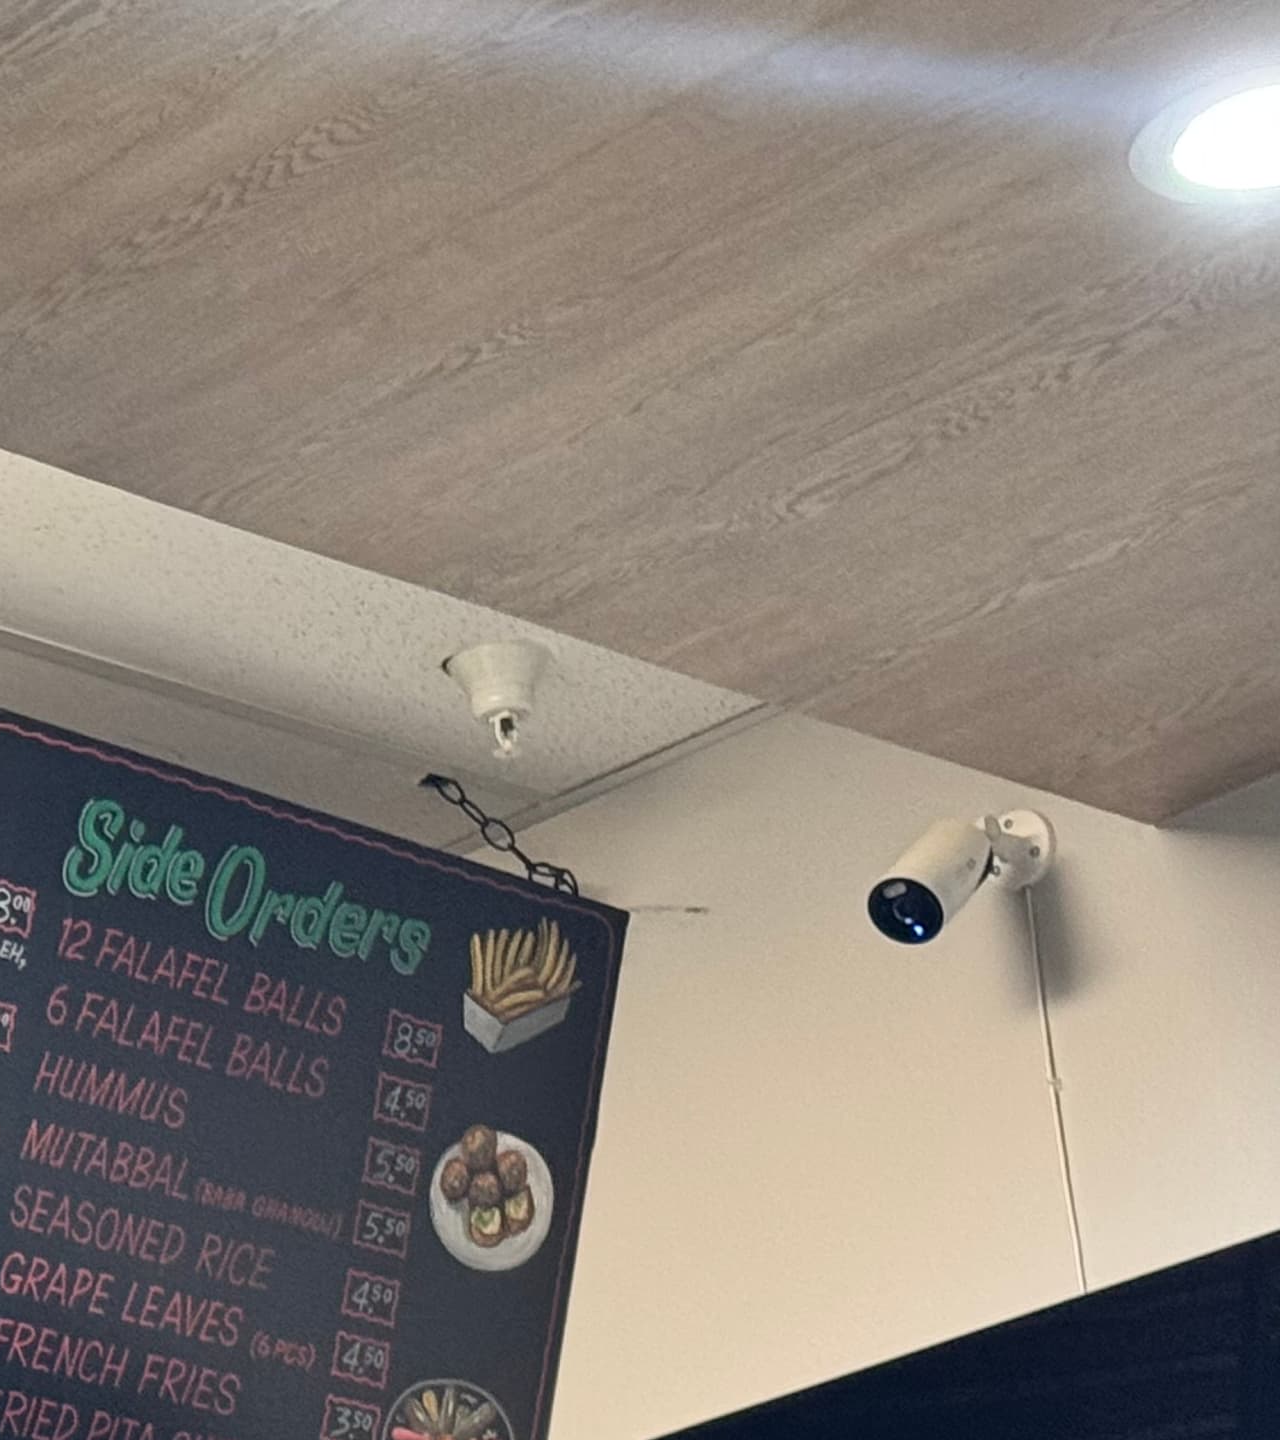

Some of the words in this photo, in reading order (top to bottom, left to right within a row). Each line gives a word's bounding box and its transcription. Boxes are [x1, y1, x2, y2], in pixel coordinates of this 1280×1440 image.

[61, 798, 206, 907] Side
[205, 843, 432, 976] Orders
[57, 916, 94, 962] 12
[94, 927, 230, 1007] FALAFEL
[242, 970, 348, 1037] BALLS
[18, 1117, 189, 1202] MUTABBAL
[120, 1280, 245, 1348] LEAVES
[136, 1352, 243, 1417] FRIES
